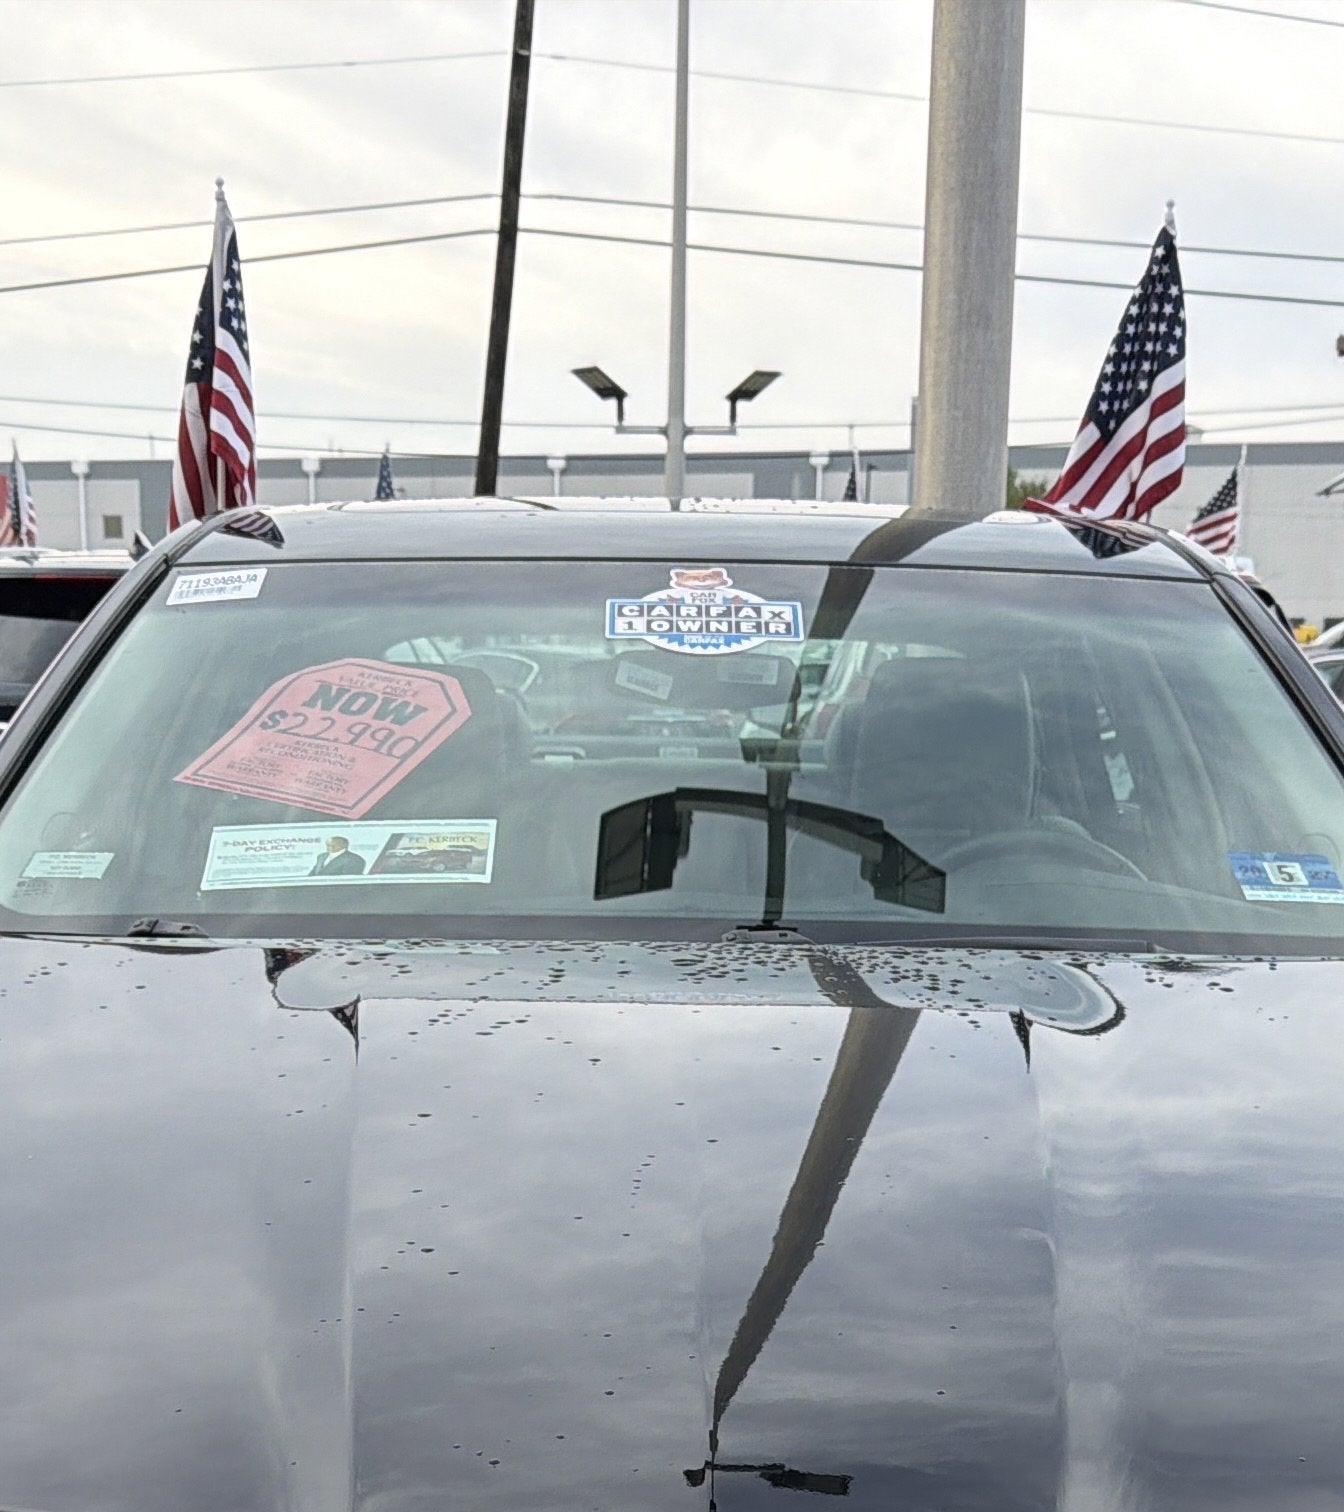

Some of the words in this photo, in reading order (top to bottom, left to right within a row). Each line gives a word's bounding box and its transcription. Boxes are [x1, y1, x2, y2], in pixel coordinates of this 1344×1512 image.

[621, 605, 787, 621] CARFAX
[622, 621, 638, 631] 1
[650, 619, 787, 634] OWNER
[304, 683, 429, 727] NOW
[258, 837, 322, 846] EXCHANGE
[428, 833, 479, 845] KERBECK
[1275, 864, 1295, 883] 5
